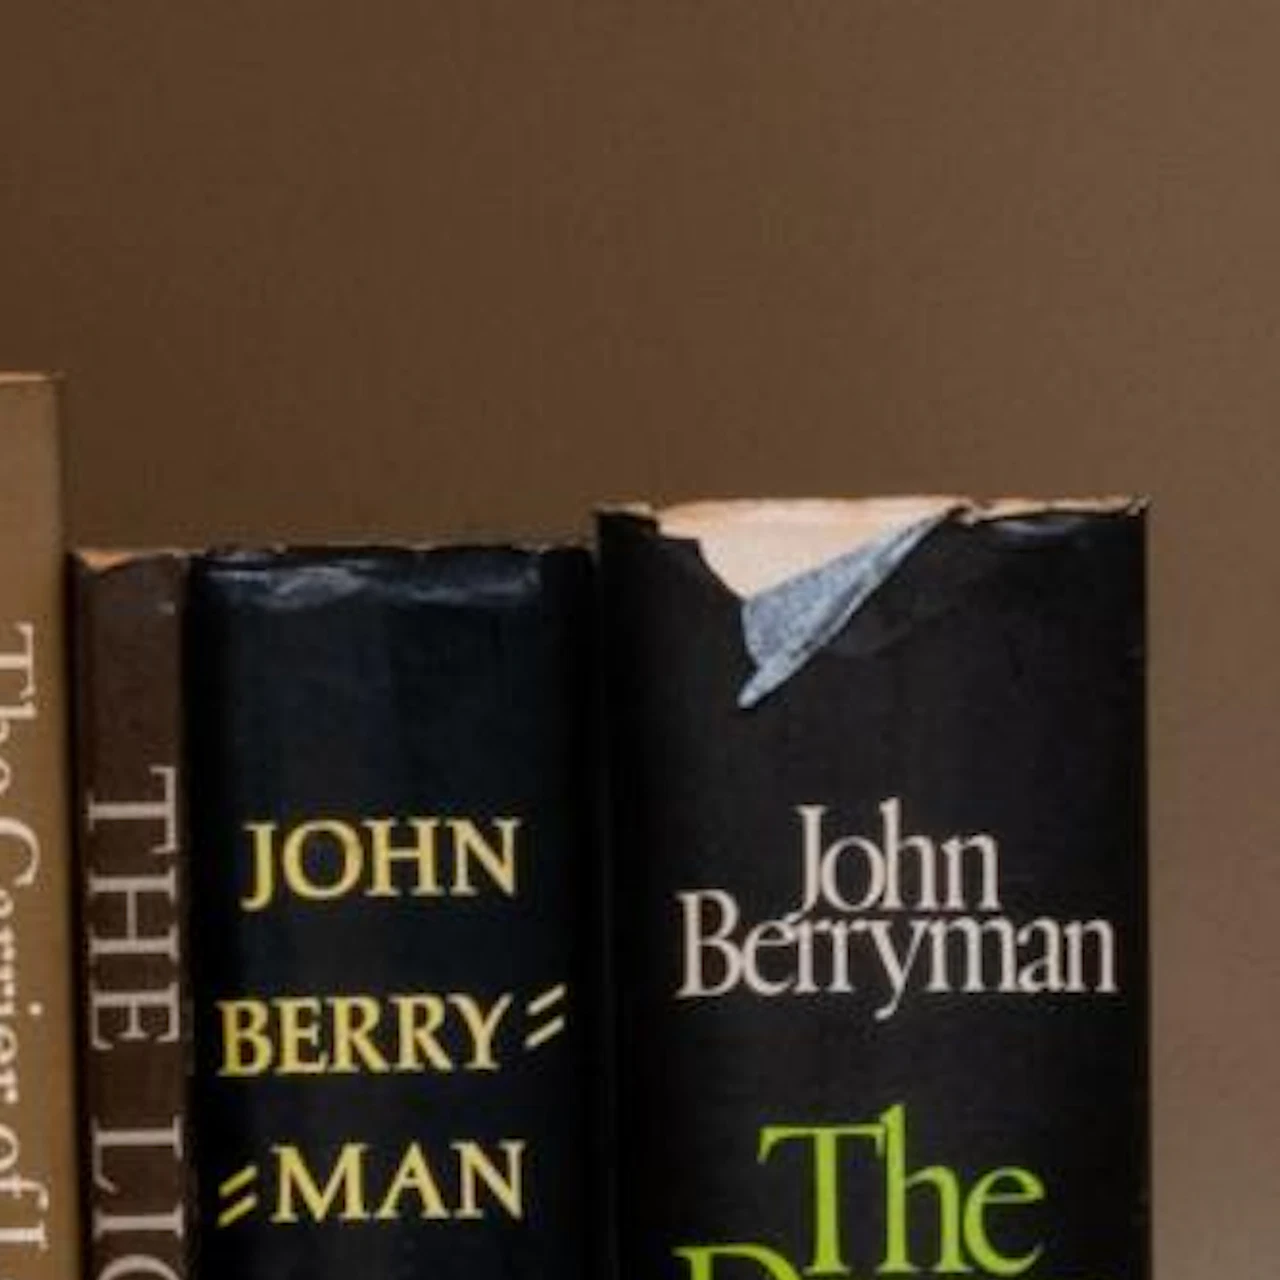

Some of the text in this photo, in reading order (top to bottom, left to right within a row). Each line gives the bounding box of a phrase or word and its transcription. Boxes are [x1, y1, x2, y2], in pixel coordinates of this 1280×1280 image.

[86, 764, 181, 1050] THE
[241, 816, 523, 912] JOHN
[783, 797, 1001, 924] John
[675, 887, 1119, 1022] Berryman
[756, 1103, 1046, 1276] The
